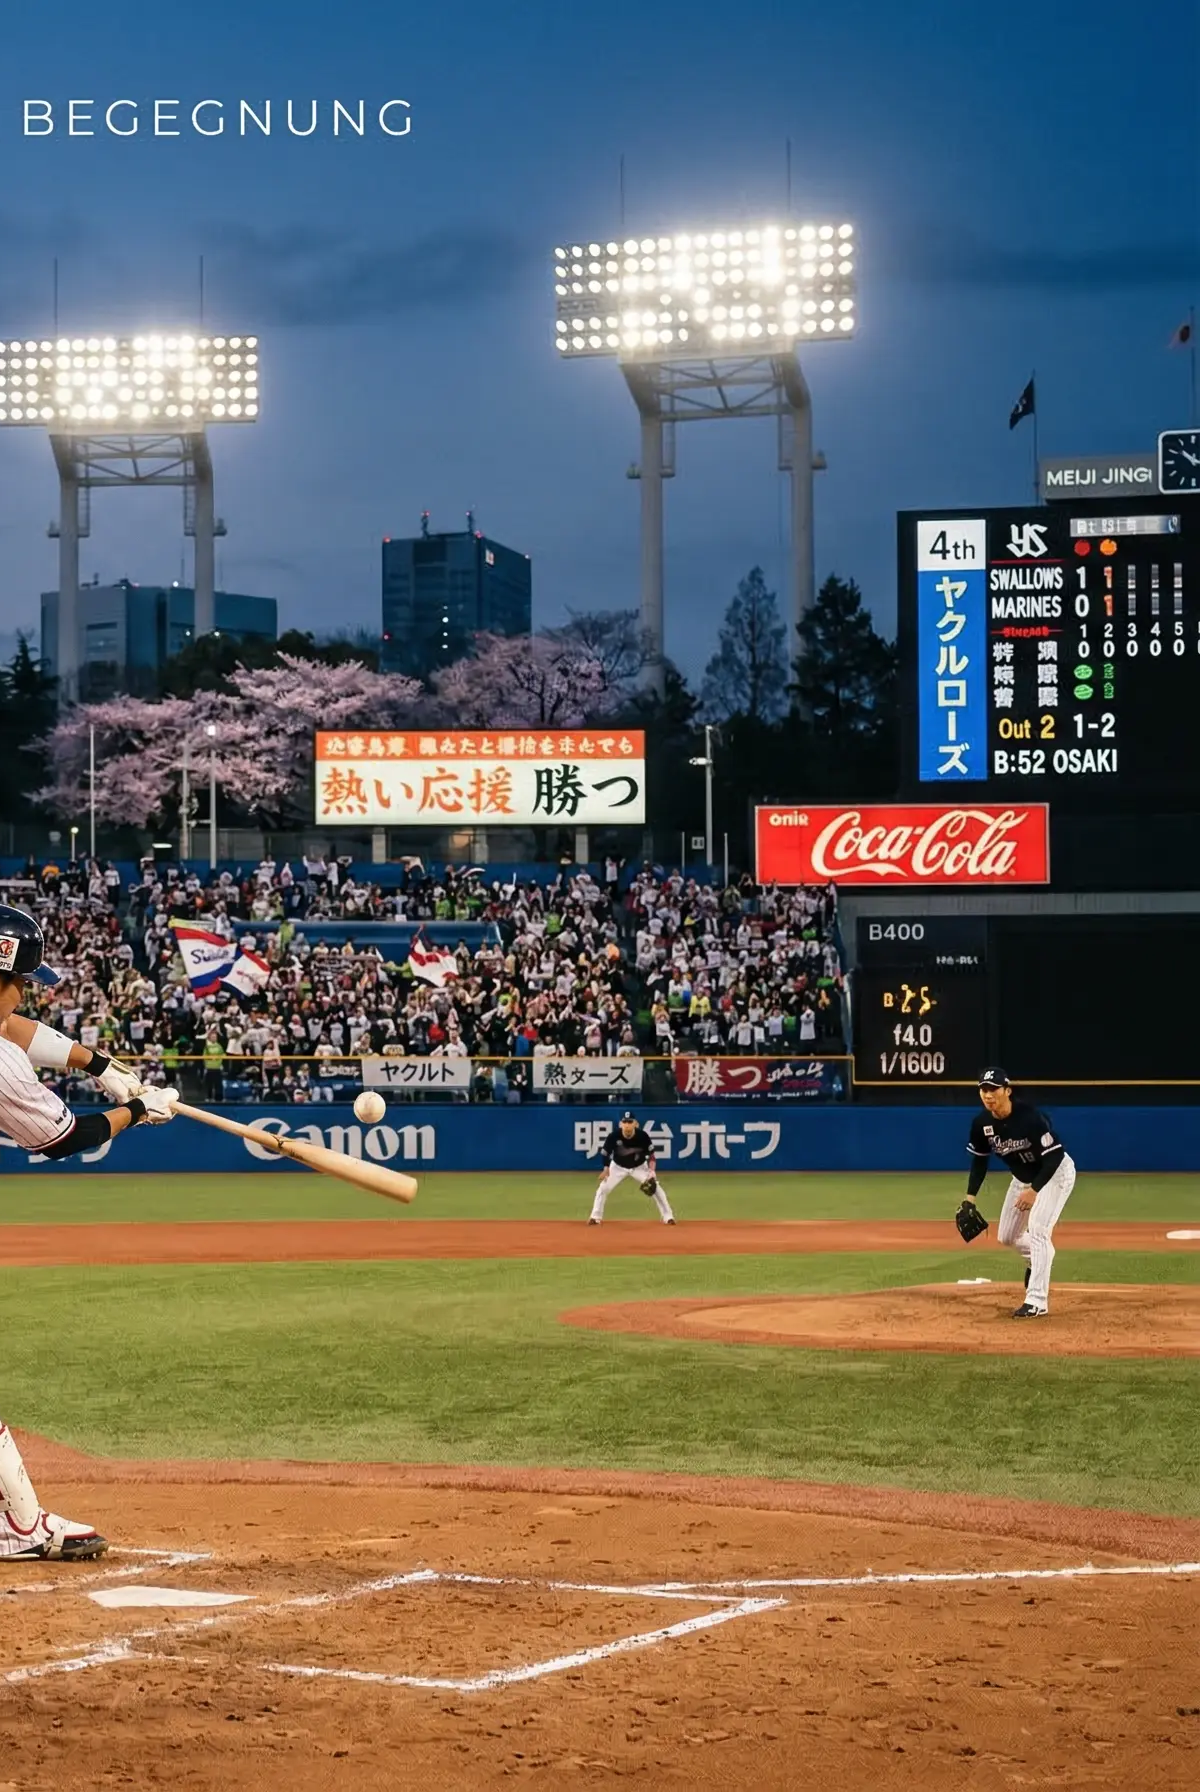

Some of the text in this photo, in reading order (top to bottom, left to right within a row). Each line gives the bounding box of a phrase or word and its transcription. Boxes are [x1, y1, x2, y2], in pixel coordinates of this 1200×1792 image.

[1046, 467, 1152, 486] MEIJI JING
[929, 530, 975, 560] 4th
[990, 567, 1063, 591] SWALLOWS
[1076, 566, 1086, 589] 1
[991, 596, 1062, 619] MARINES
[1074, 594, 1090, 618] 0
[1080, 620, 1184, 638] 1 2 3 4 5
[1078, 640, 1091, 658] 0
[1103, 640, 1115, 658] 0
[1126, 639, 1139, 657] 0
[1150, 639, 1162, 657] 0
[1173, 638, 1186, 656] 0
[935, 575, 970, 775] ヤクルローズ
[998, 714, 1056, 740] Out 2
[1073, 712, 1116, 739] 1-2
[994, 749, 1118, 774] B:52 OSAKI
[321, 763, 639, 817] 熱い応援 勝つ
[811, 810, 1029, 877] Coca-Cola
[869, 923, 925, 941] B400
[380, 1061, 455, 1083] ヤクルト
[880, 1051, 945, 1075] 1/1600
[684, 1057, 762, 1097] 勝つ
[243, 1117, 436, 1161] Canon
